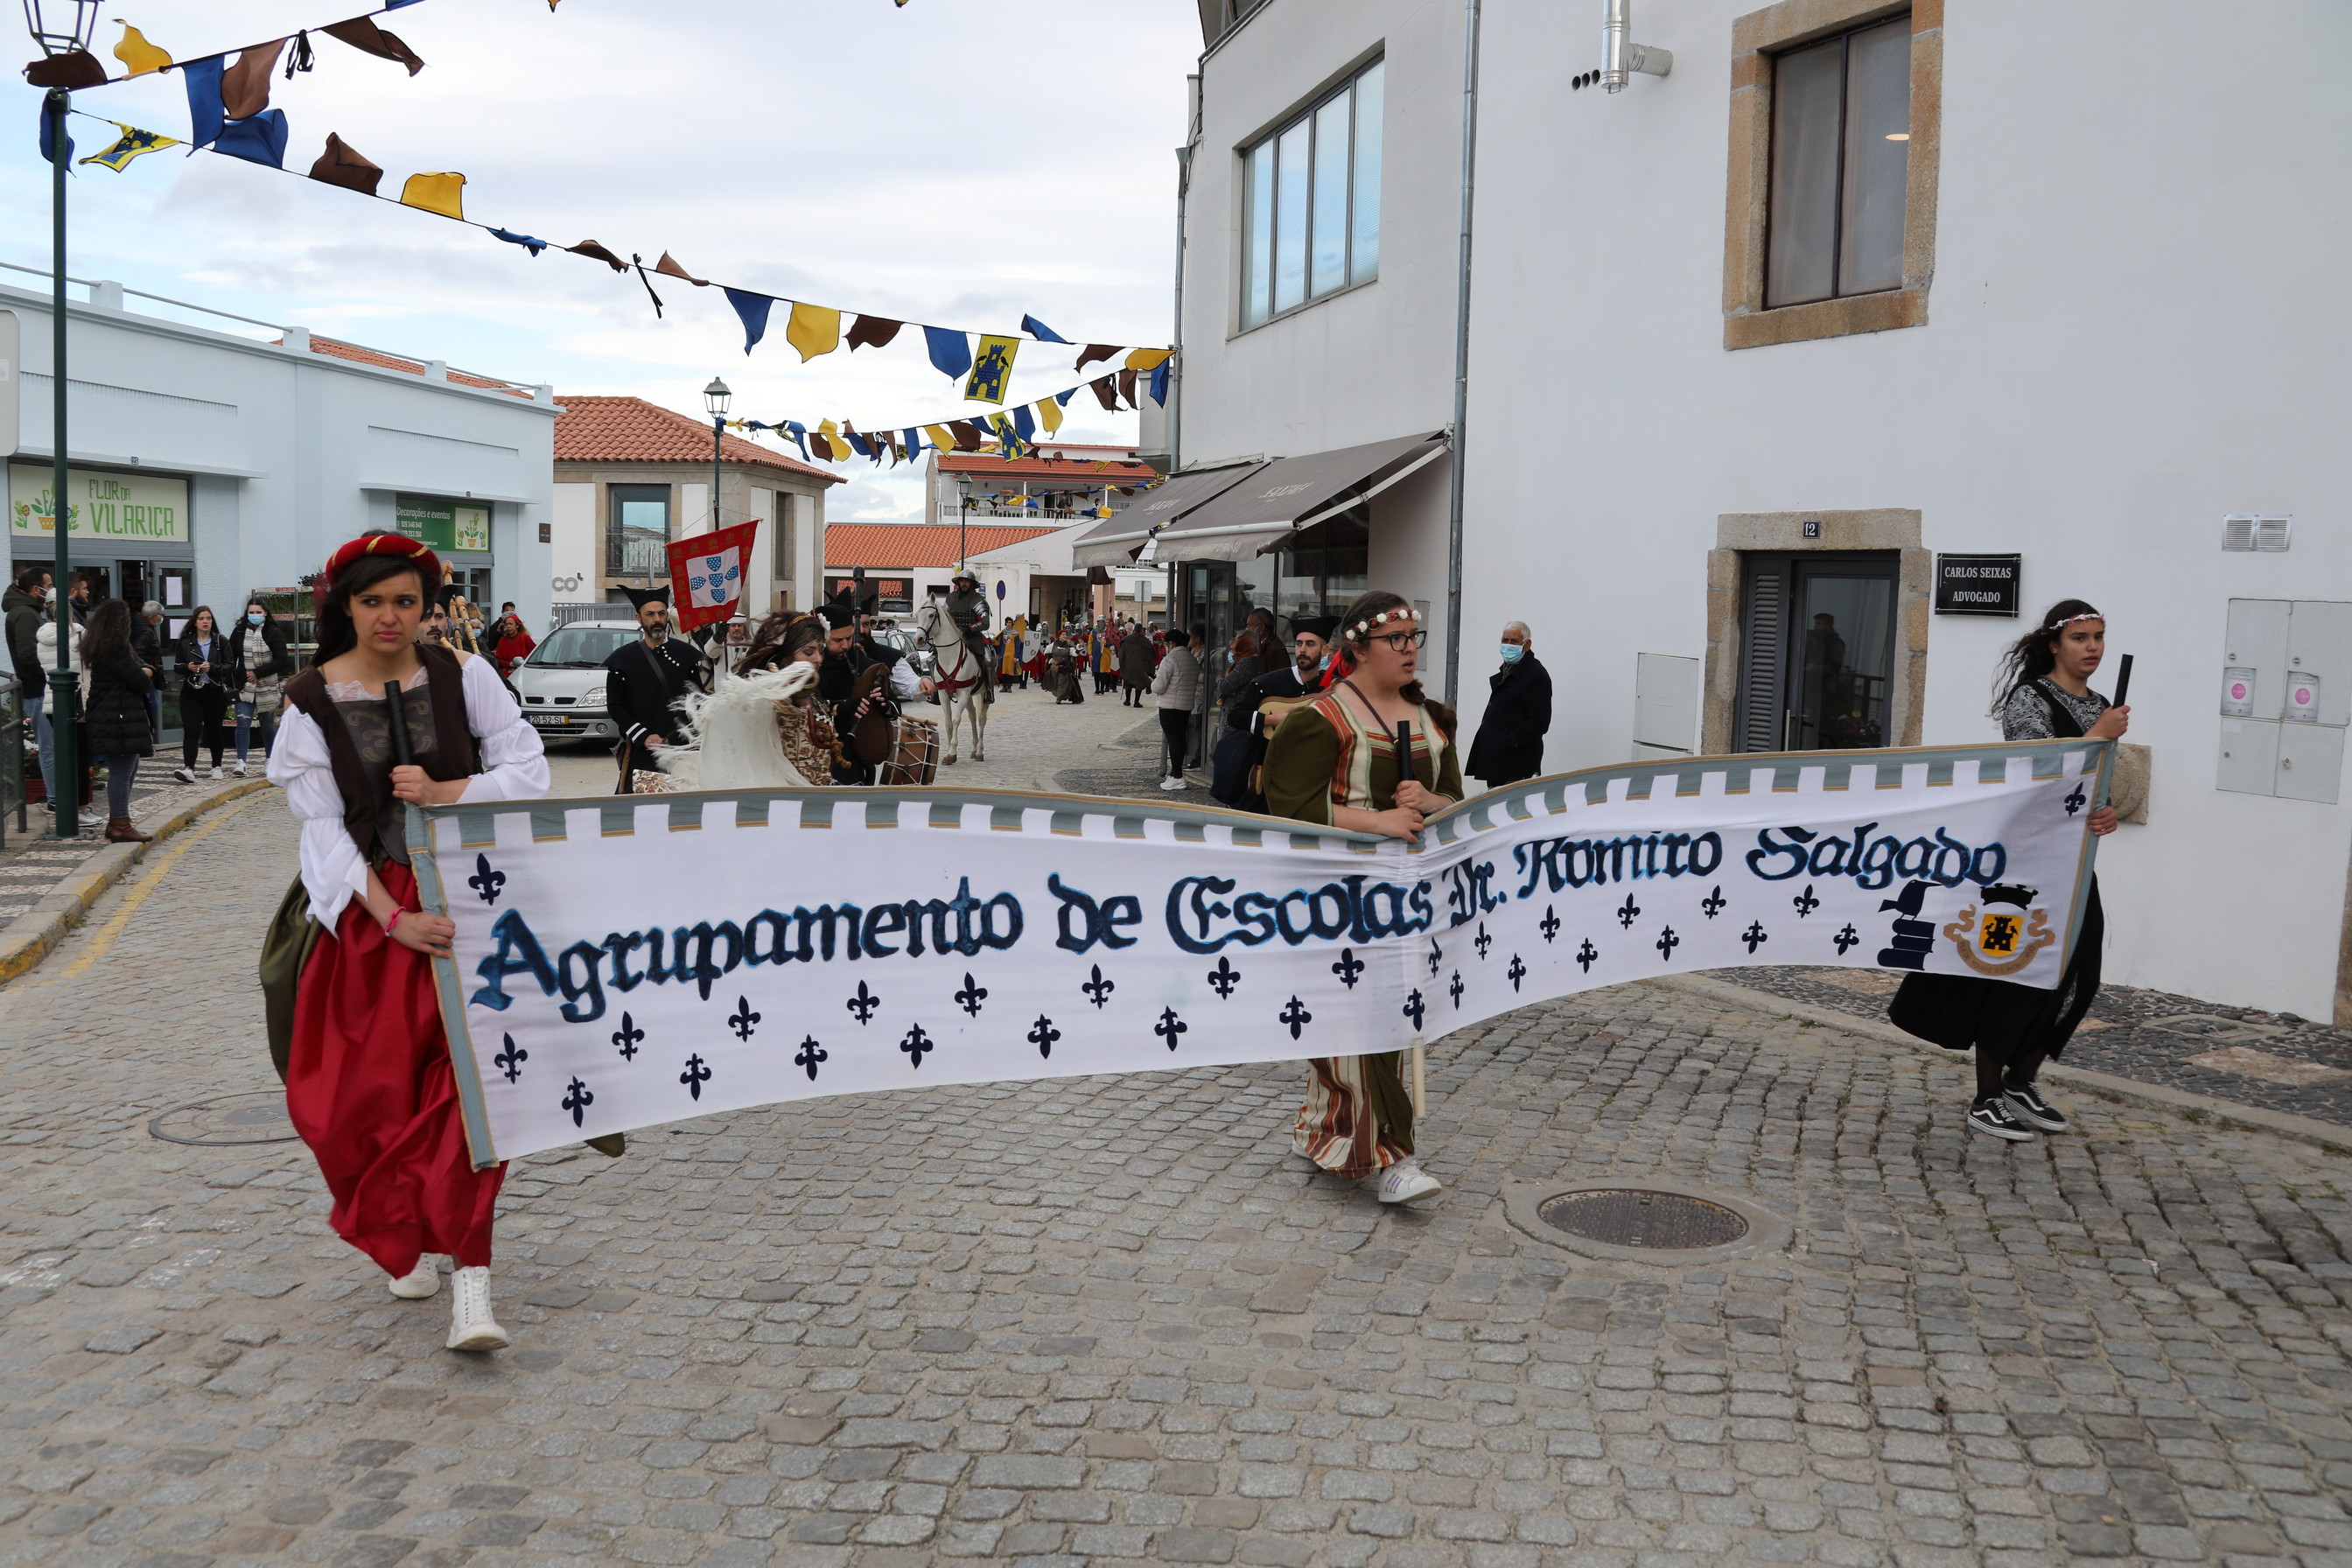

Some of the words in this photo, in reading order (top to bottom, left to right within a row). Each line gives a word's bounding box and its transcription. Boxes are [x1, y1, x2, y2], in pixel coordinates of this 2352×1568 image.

[88, 479, 119, 500] FLOR
[121, 486, 131, 501] DA
[89, 502, 174, 537] VILARIÇA
[396, 507, 426, 519] Decorações
[430, 511, 451, 520] eventos
[1805, 522, 1816, 536] 12
[1944, 566, 1978, 578] CARLOS
[1979, 567, 2012, 578] SEIXAS
[1952, 591, 2000, 603] ADVOGADO
[531, 716, 564, 724] 20-52-SL
[467, 875, 1026, 1023] Agrupamento
[1047, 871, 1143, 955] de
[1165, 875, 1433, 955] Escolas
[1442, 857, 1508, 929] Dr.
[1745, 822, 2007, 890] Salgado
